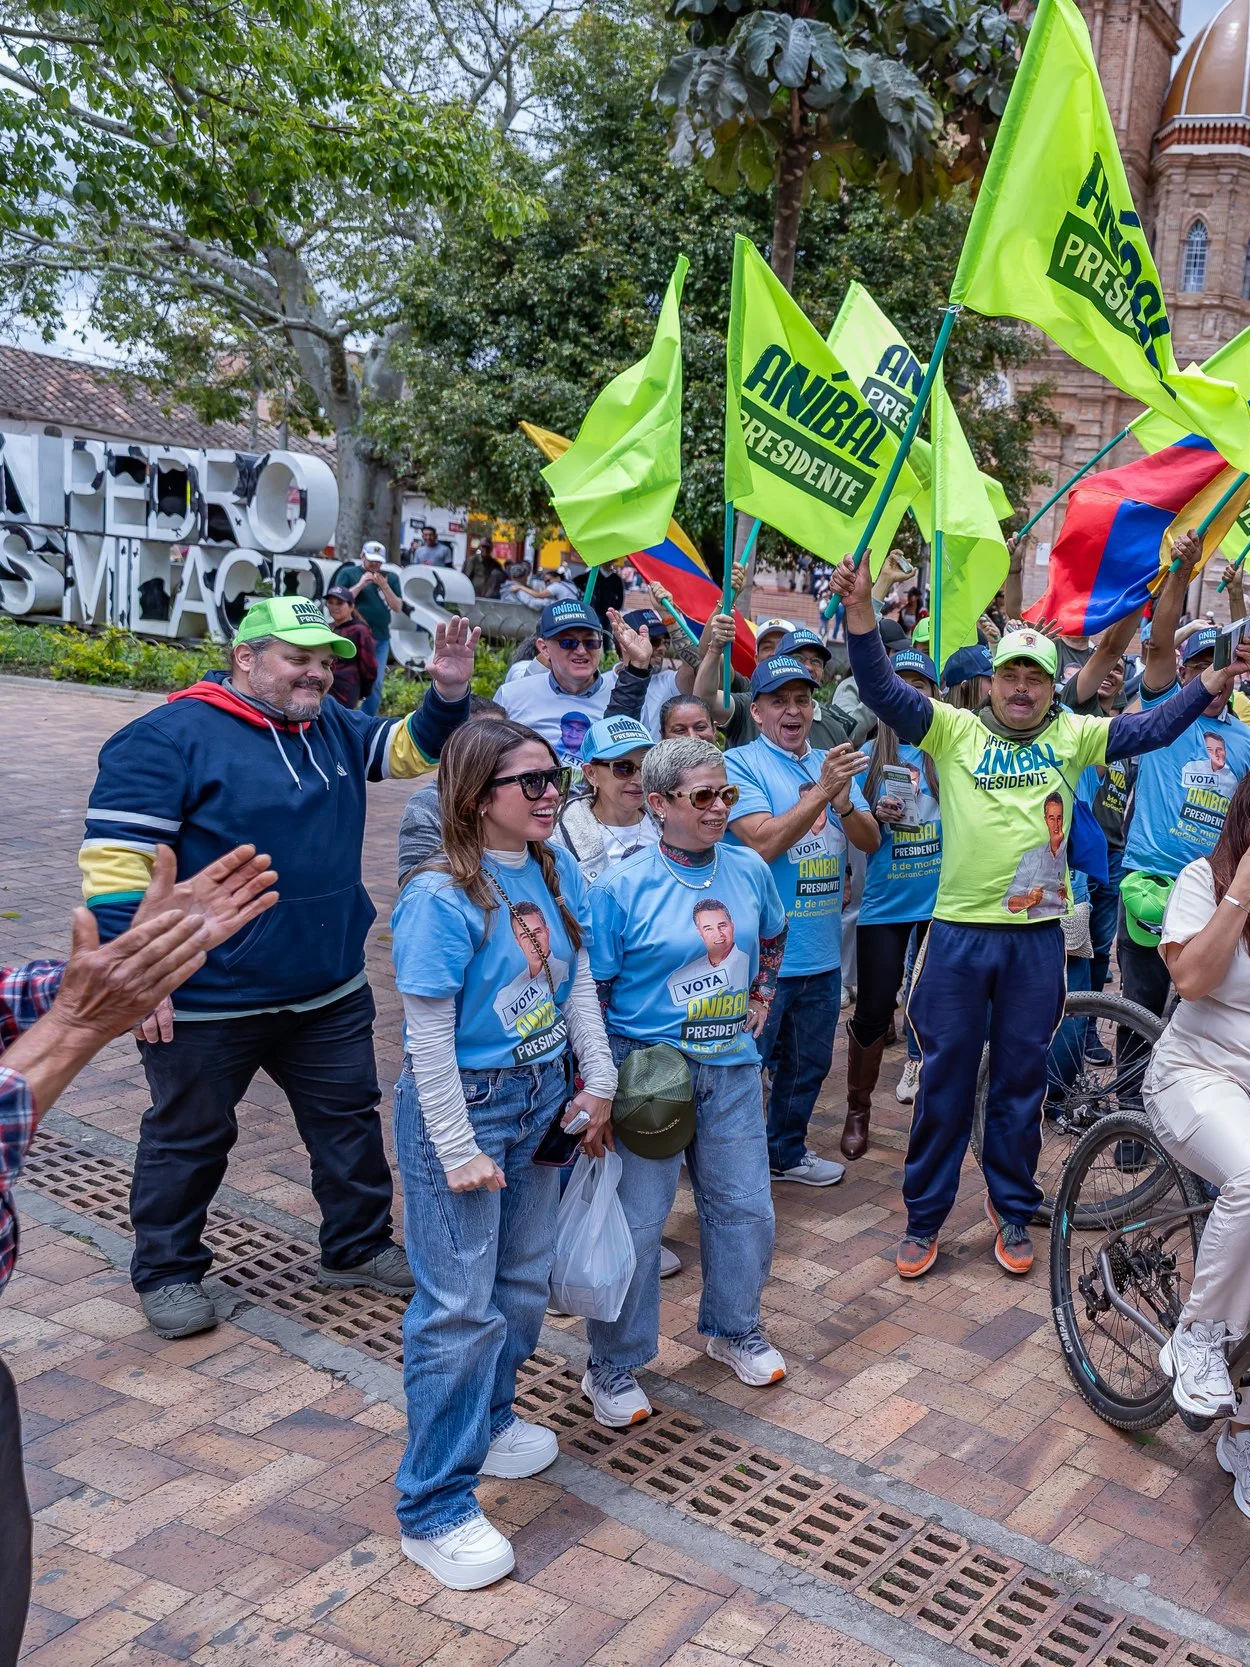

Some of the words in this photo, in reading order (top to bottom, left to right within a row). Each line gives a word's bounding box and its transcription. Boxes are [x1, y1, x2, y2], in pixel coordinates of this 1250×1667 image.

[742, 344, 887, 469] ANÍBAL
[552, 601, 585, 616] ANÍBAL
[1198, 629, 1216, 640] ANÍB
[768, 656, 801, 670] ANÍBAL
[896, 650, 924, 663] ANÍBAL
[1190, 775, 1215, 784] VOTA
[1184, 807, 1225, 828] PRESIDENT
[1200, 829, 1220, 839] mar
[796, 841, 821, 855] VOTA
[894, 842, 940, 857] PRESIDENTE
[900, 862, 911, 870] de
[887, 868, 942, 879] #laGranConsu
[800, 881, 839, 893] PRESIDENTE
[682, 975, 723, 994] VOTA
[510, 986, 538, 1015] VOTA
